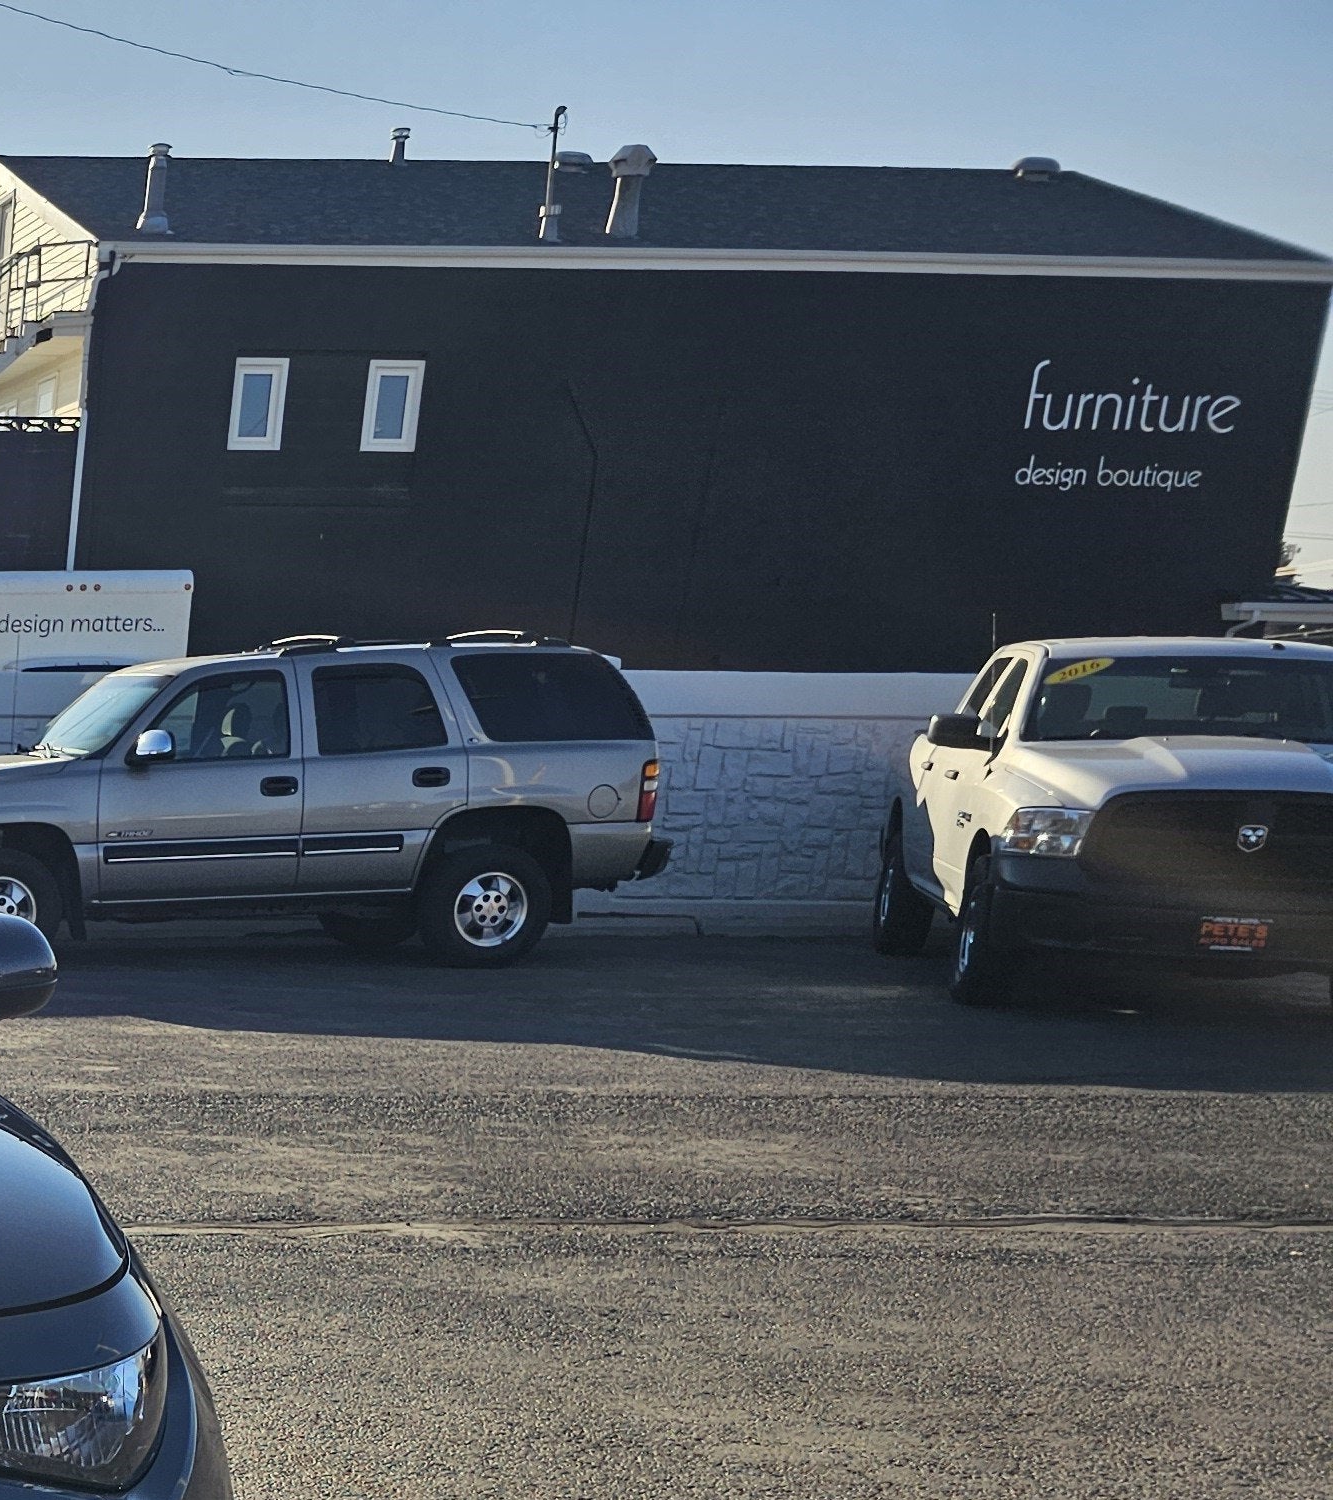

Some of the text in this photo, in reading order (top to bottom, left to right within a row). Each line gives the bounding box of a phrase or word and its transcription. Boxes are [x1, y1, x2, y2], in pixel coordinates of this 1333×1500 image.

[1023, 358, 1241, 434] furniture
[1015, 454, 1203, 493] design boutique
[70, 614, 166, 634] matters...
[1059, 661, 1100, 681] 2016
